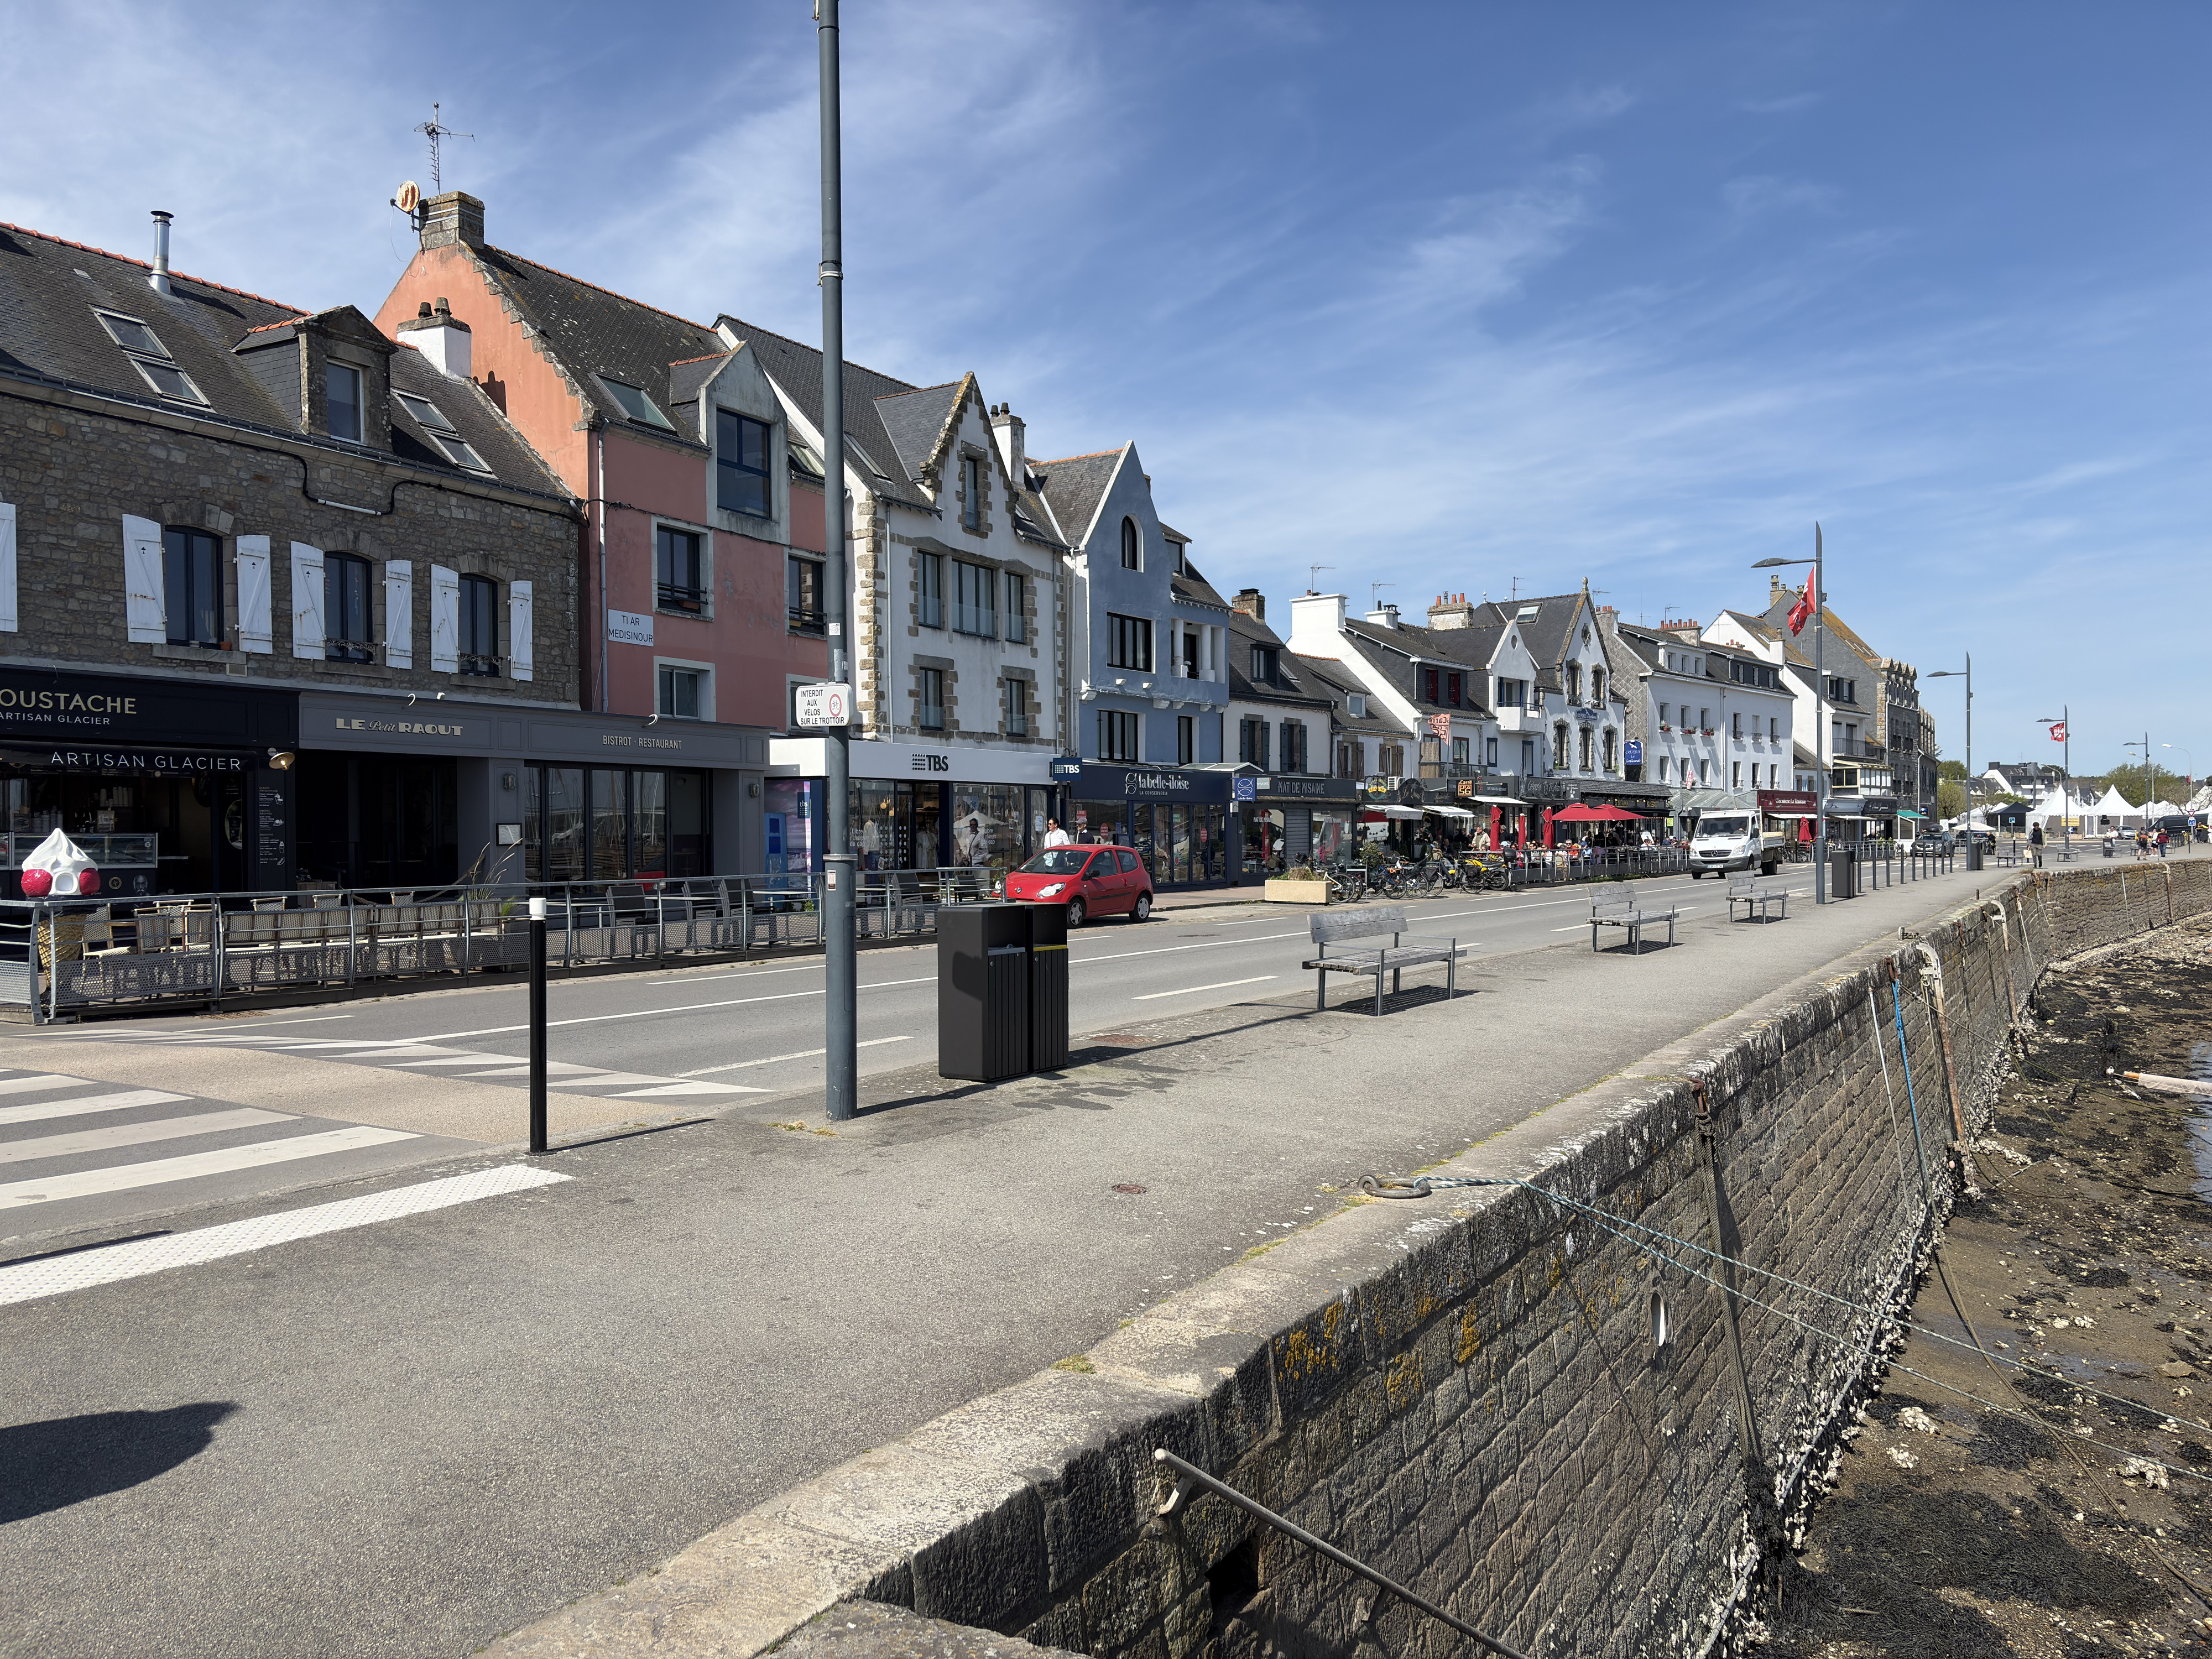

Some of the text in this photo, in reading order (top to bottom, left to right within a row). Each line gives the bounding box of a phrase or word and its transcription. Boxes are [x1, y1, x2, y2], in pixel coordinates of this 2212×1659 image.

[622, 615, 640, 626] TI AR
[608, 628, 653, 643] MEDISINOUR
[0, 689, 137, 714] OUSTACHE
[804, 707, 821, 716] VÉLOS
[58, 715, 110, 725] GLACIER
[336, 718, 463, 736] LE Petit RAOUT
[603, 735, 682, 750] BISTROT RESTAURANT
[51, 752, 241, 770] ARTISAN GLACIER
[926, 754, 949, 771] TBS
[1063, 765, 1080, 774] TBS
[1278, 781, 1324, 794] MAT DE MISAINE
